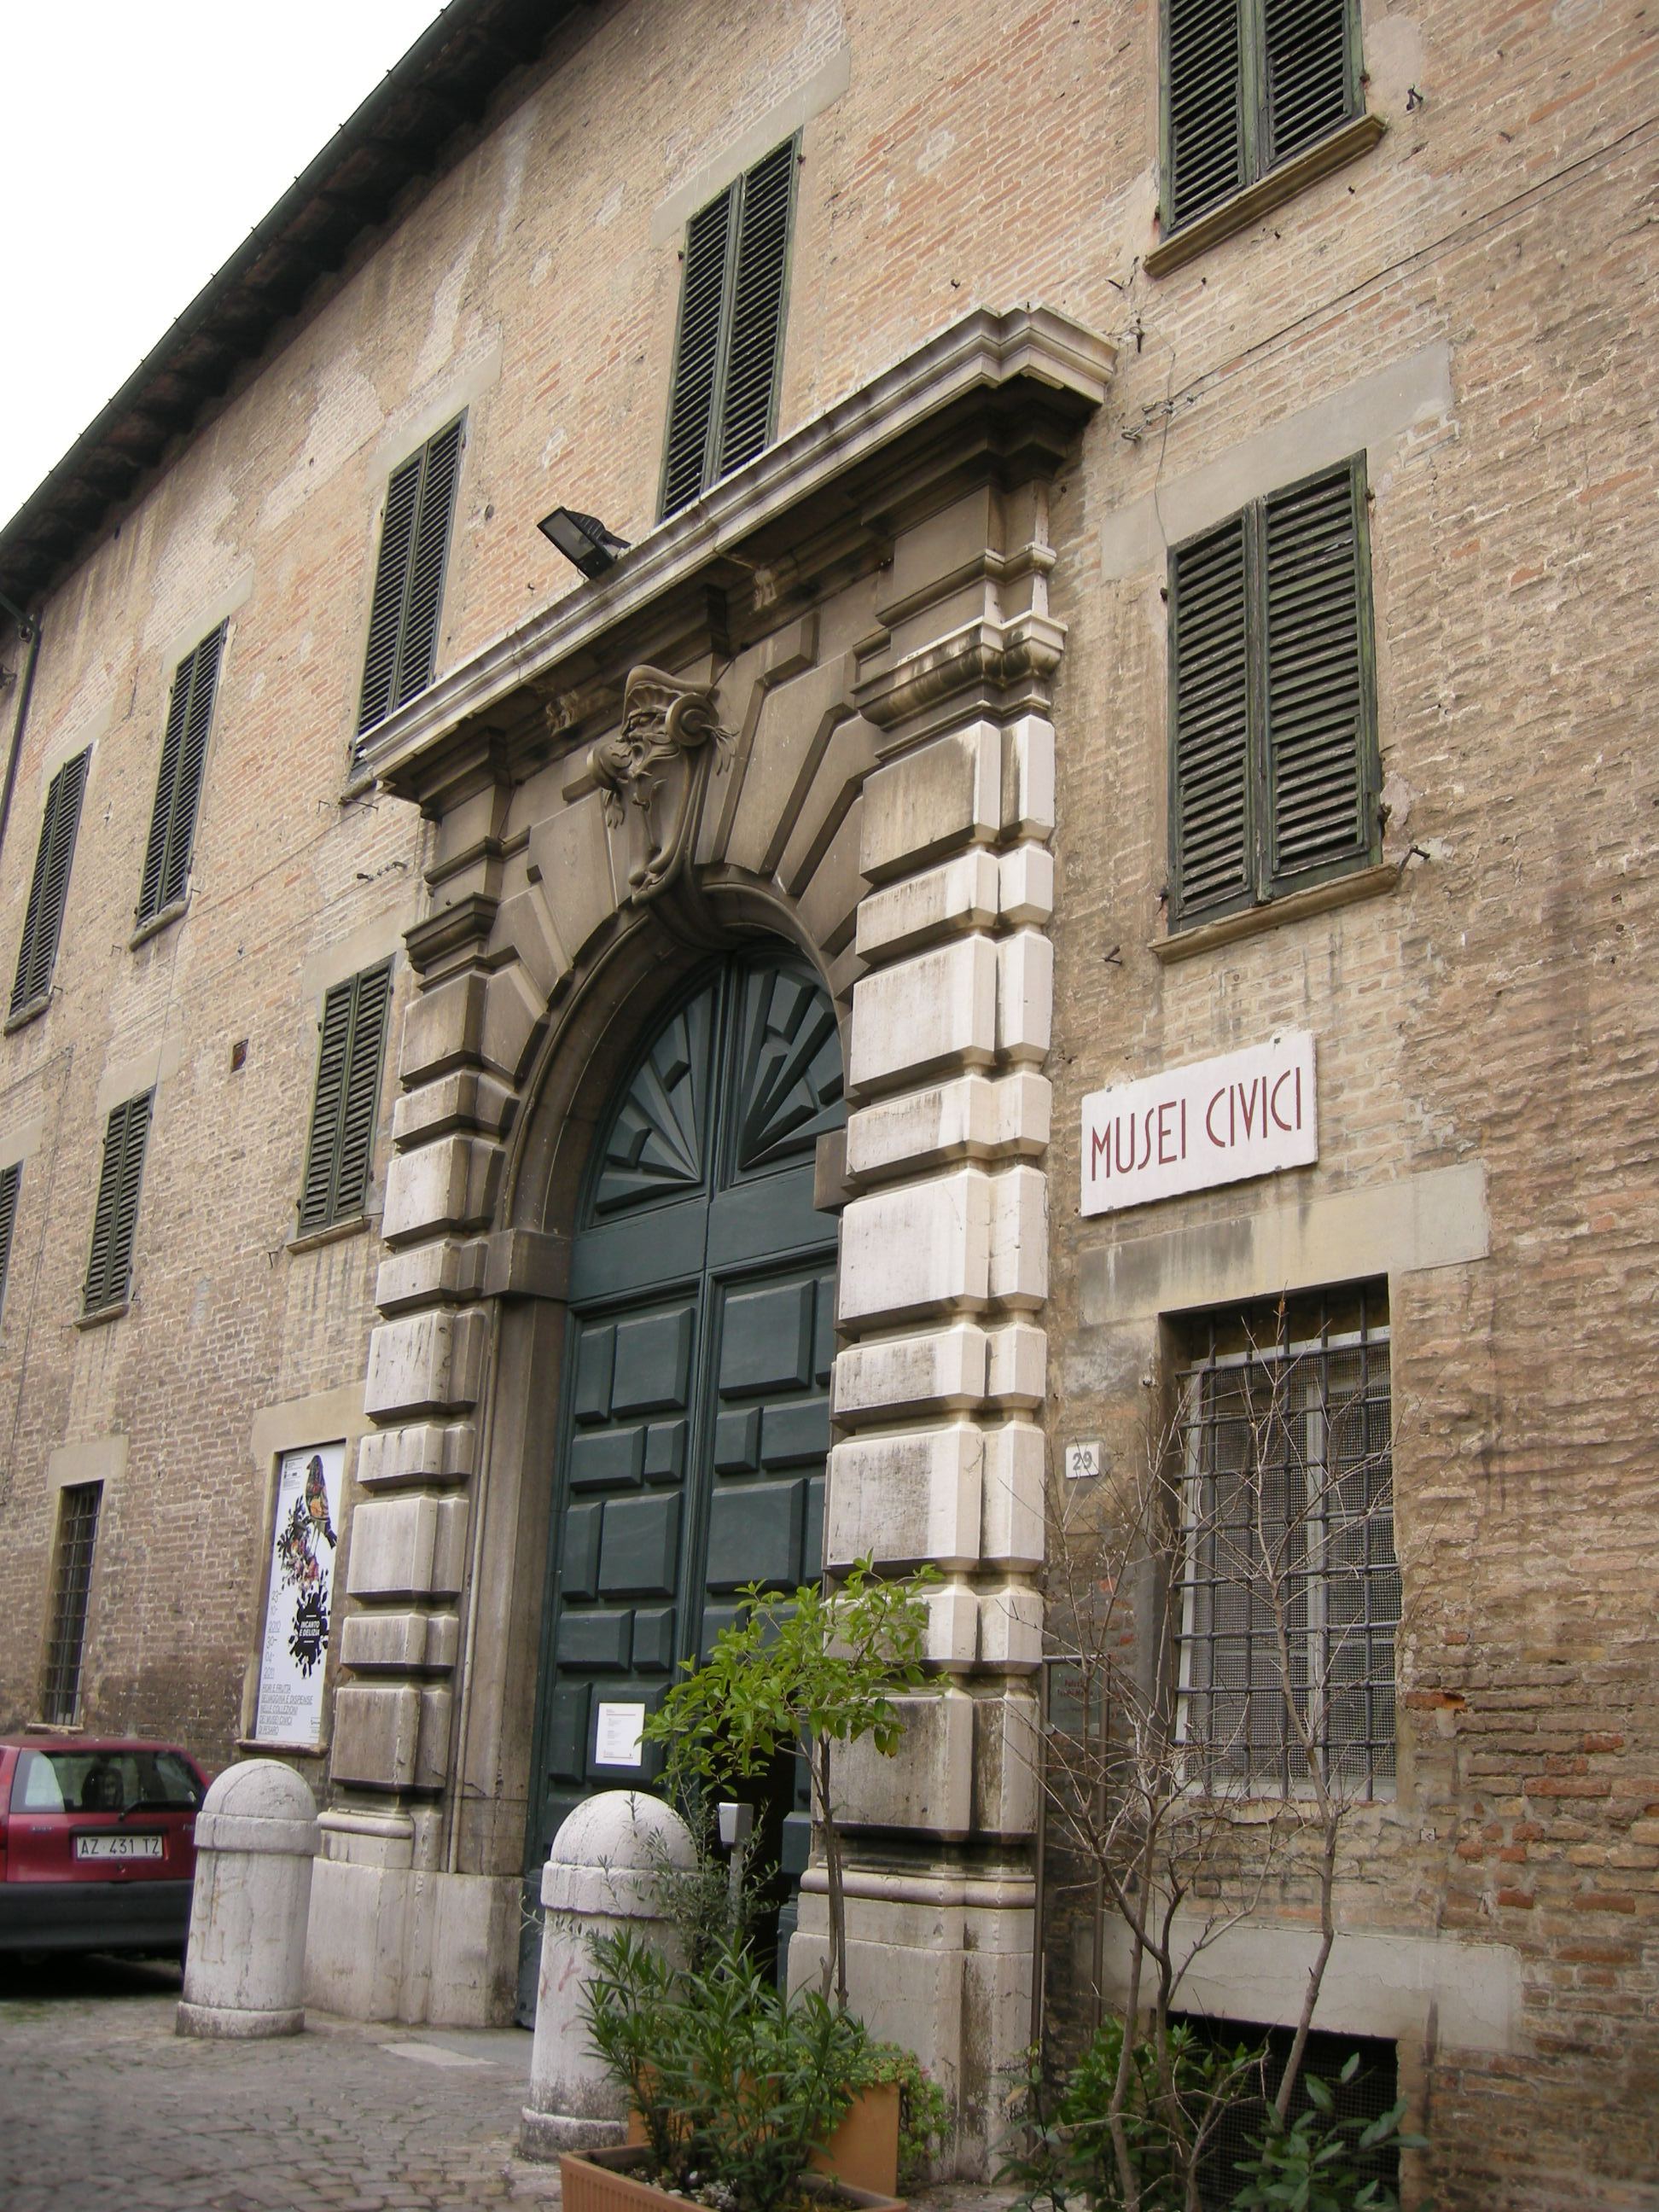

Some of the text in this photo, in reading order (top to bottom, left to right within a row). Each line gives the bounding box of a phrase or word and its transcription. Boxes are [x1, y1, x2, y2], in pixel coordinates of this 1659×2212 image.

[1091, 1067, 1301, 1182] MUSEI CIVICI
[1073, 1451, 1092, 1470] 29
[81, 1837, 160, 1855] AZ 431 TZ
